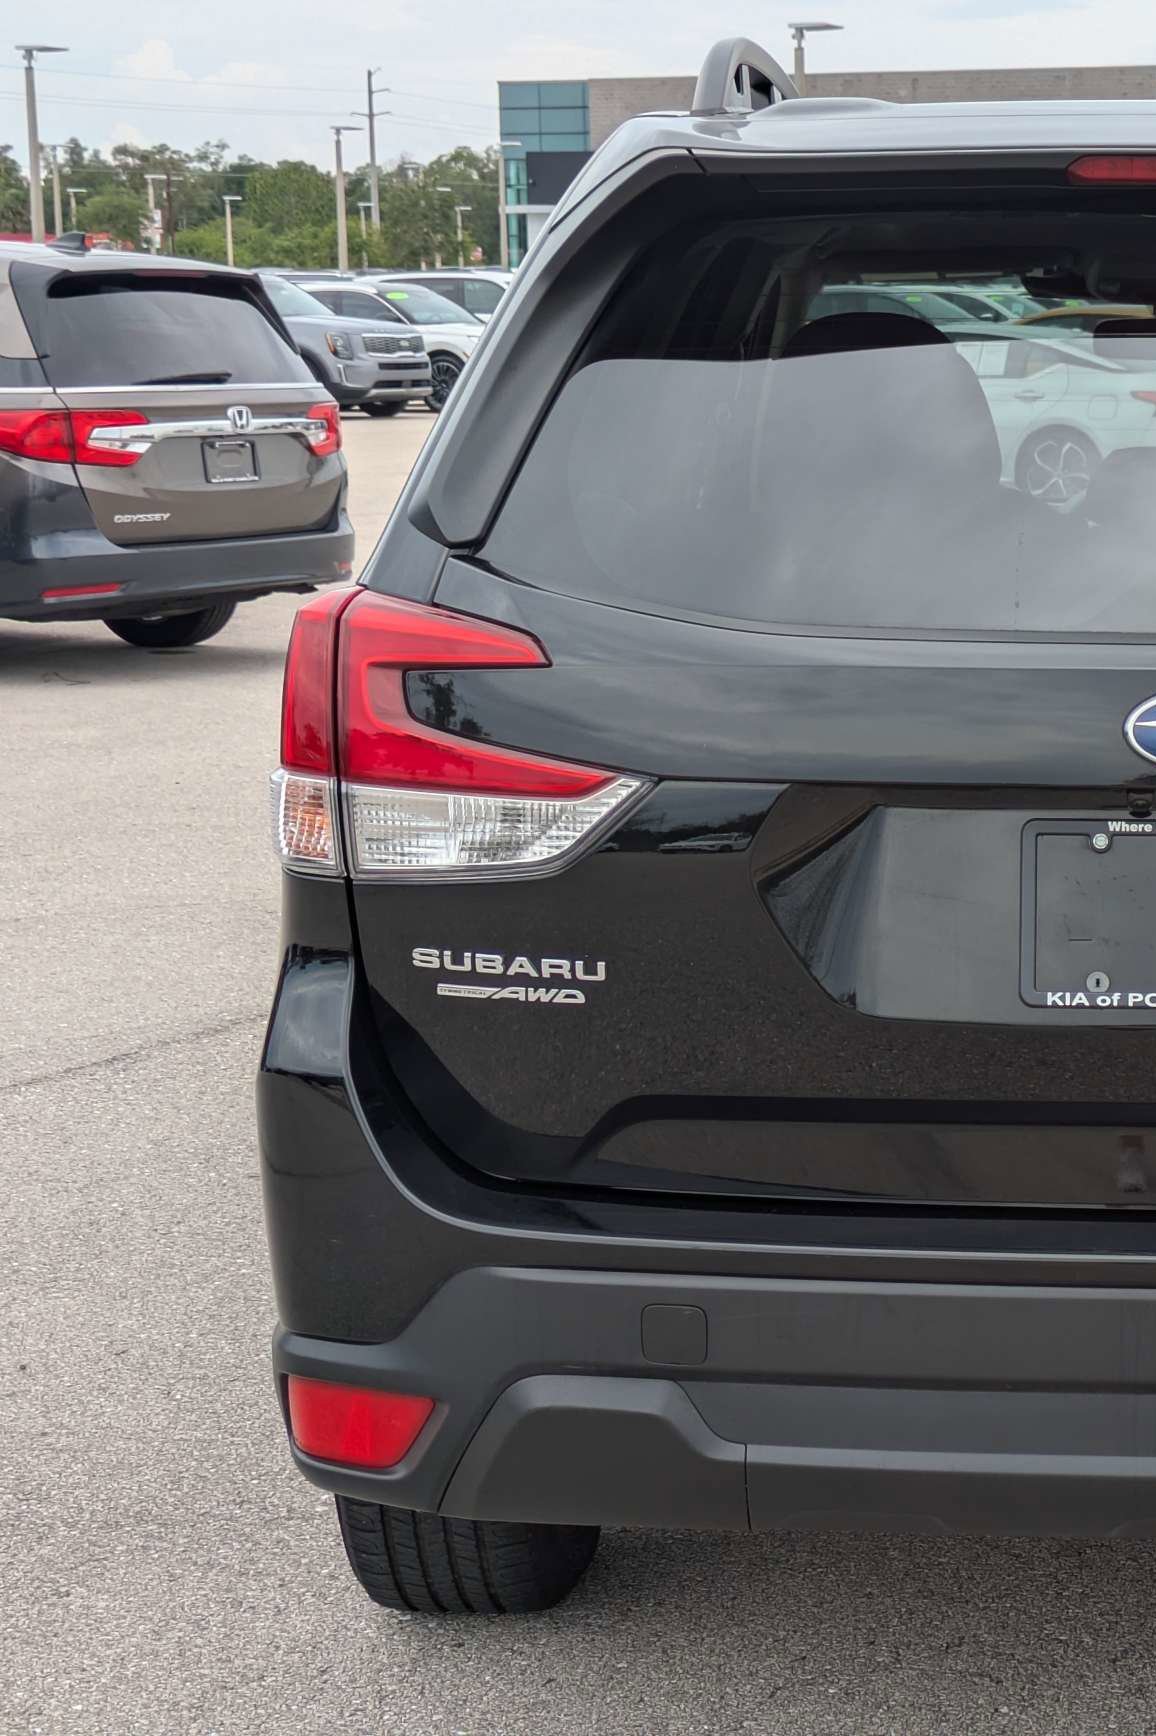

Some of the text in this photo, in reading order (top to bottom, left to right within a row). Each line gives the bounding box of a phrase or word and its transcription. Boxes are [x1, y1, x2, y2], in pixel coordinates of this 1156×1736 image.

[113, 512, 171, 524] ODYSSEY
[1107, 820, 1153, 833] Where
[412, 947, 606, 982] SUBARU
[490, 985, 587, 1004] AWD
[1046, 992, 1090, 1007] KIA
[1096, 992, 1122, 1007] of
